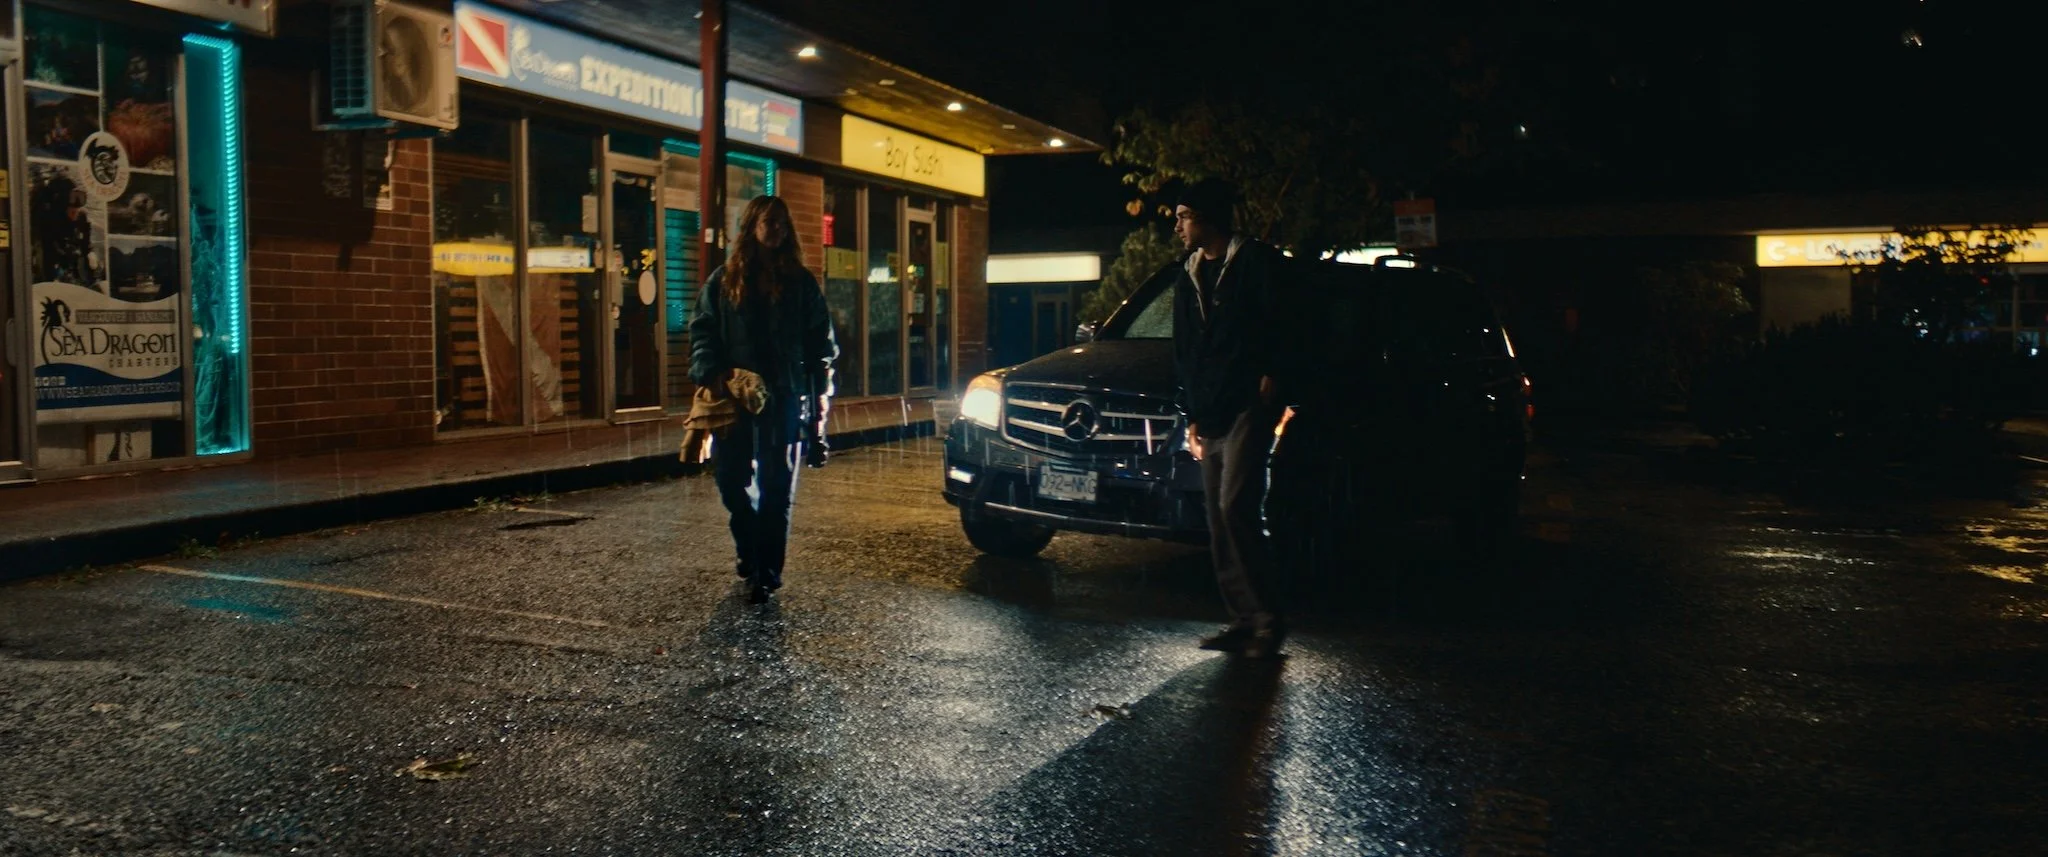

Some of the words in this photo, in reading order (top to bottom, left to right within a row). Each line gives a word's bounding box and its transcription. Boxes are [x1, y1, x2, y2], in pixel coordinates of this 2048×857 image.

[580, 54, 693, 118] EXPEDITION
[695, 88, 759, 133] CTRE
[50, 327, 87, 356] SEA
[90, 327, 177, 355] DRAGON
[109, 357, 178, 368] CHARTERS
